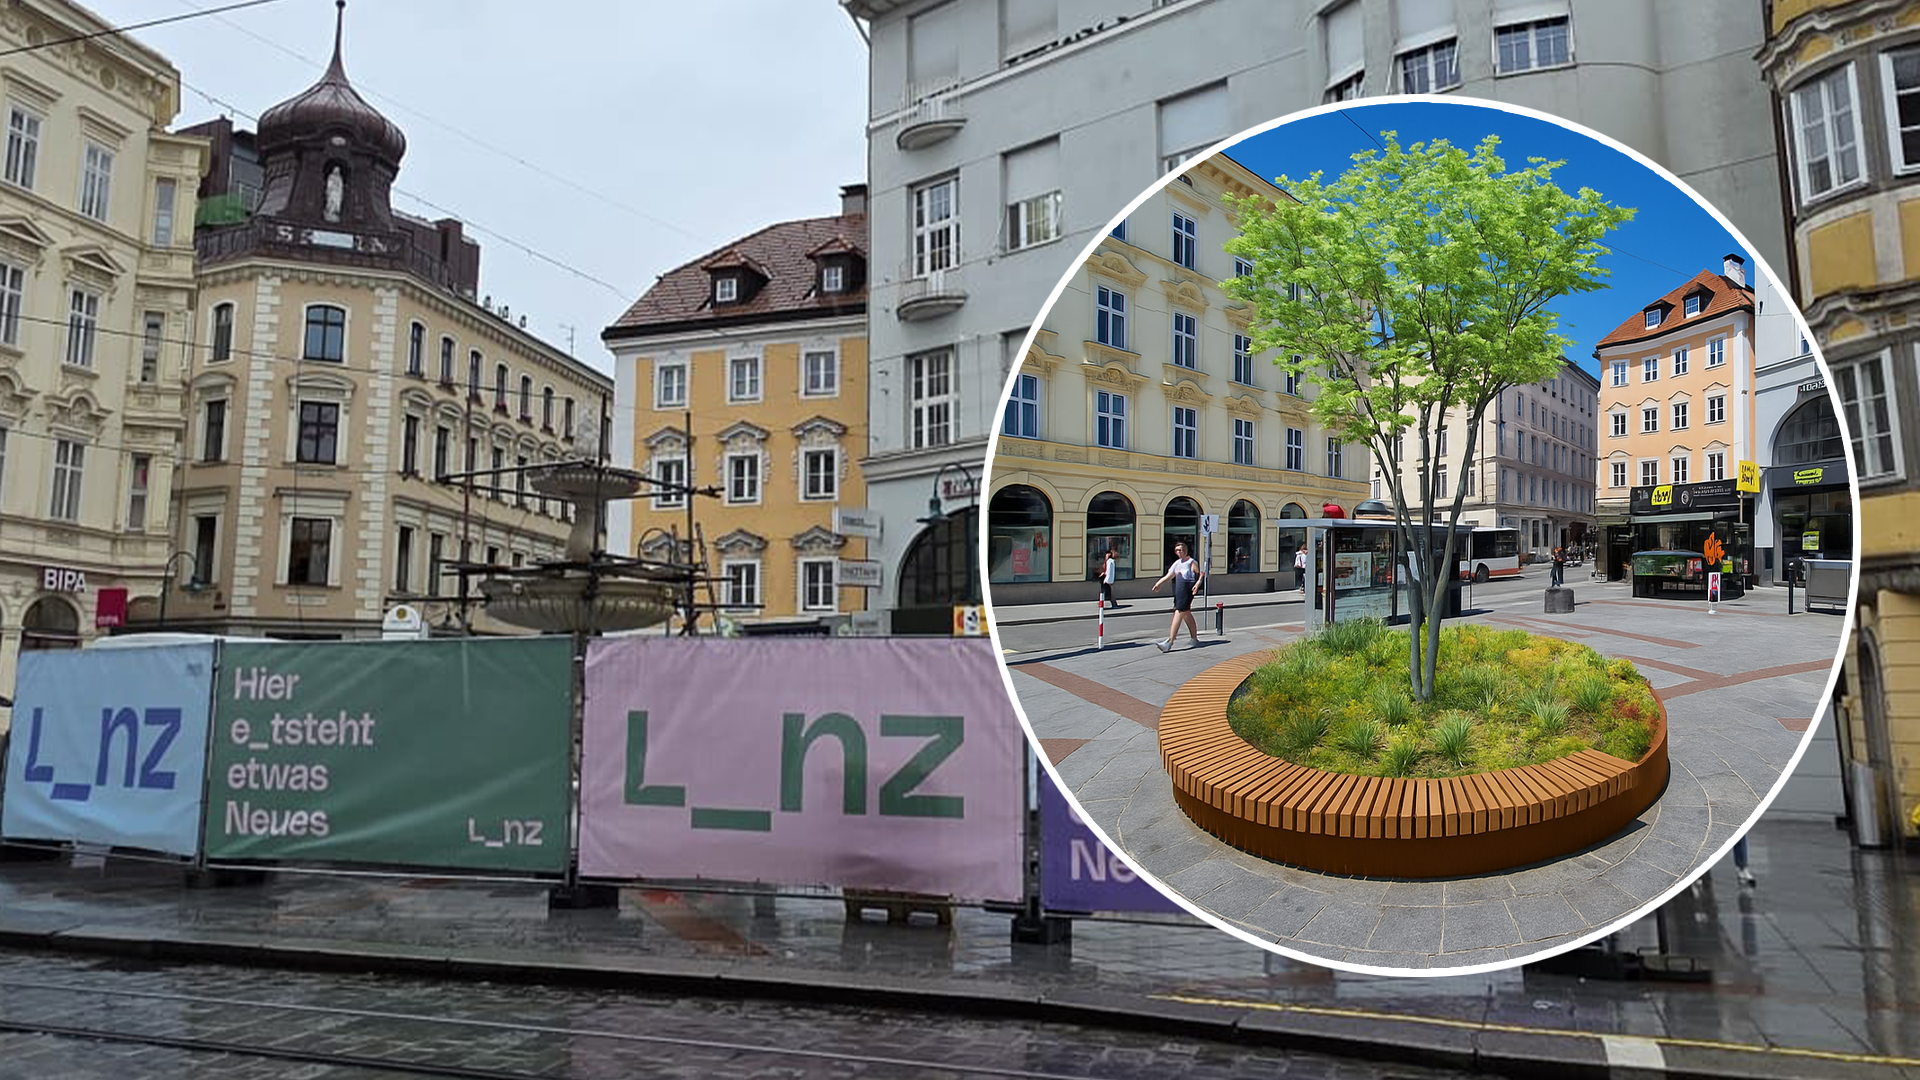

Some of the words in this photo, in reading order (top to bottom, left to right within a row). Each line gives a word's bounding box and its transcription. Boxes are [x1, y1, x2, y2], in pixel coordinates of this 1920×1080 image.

[44, 568, 86, 593] BIPA
[234, 666, 300, 700] Hier
[230, 710, 375, 749] e_tsteht
[24, 707, 182, 801] L_nz
[624, 710, 964, 831] L_nz
[227, 757, 329, 791] etwas
[225, 800, 330, 836] Neues
[468, 818, 543, 847] L_nz
